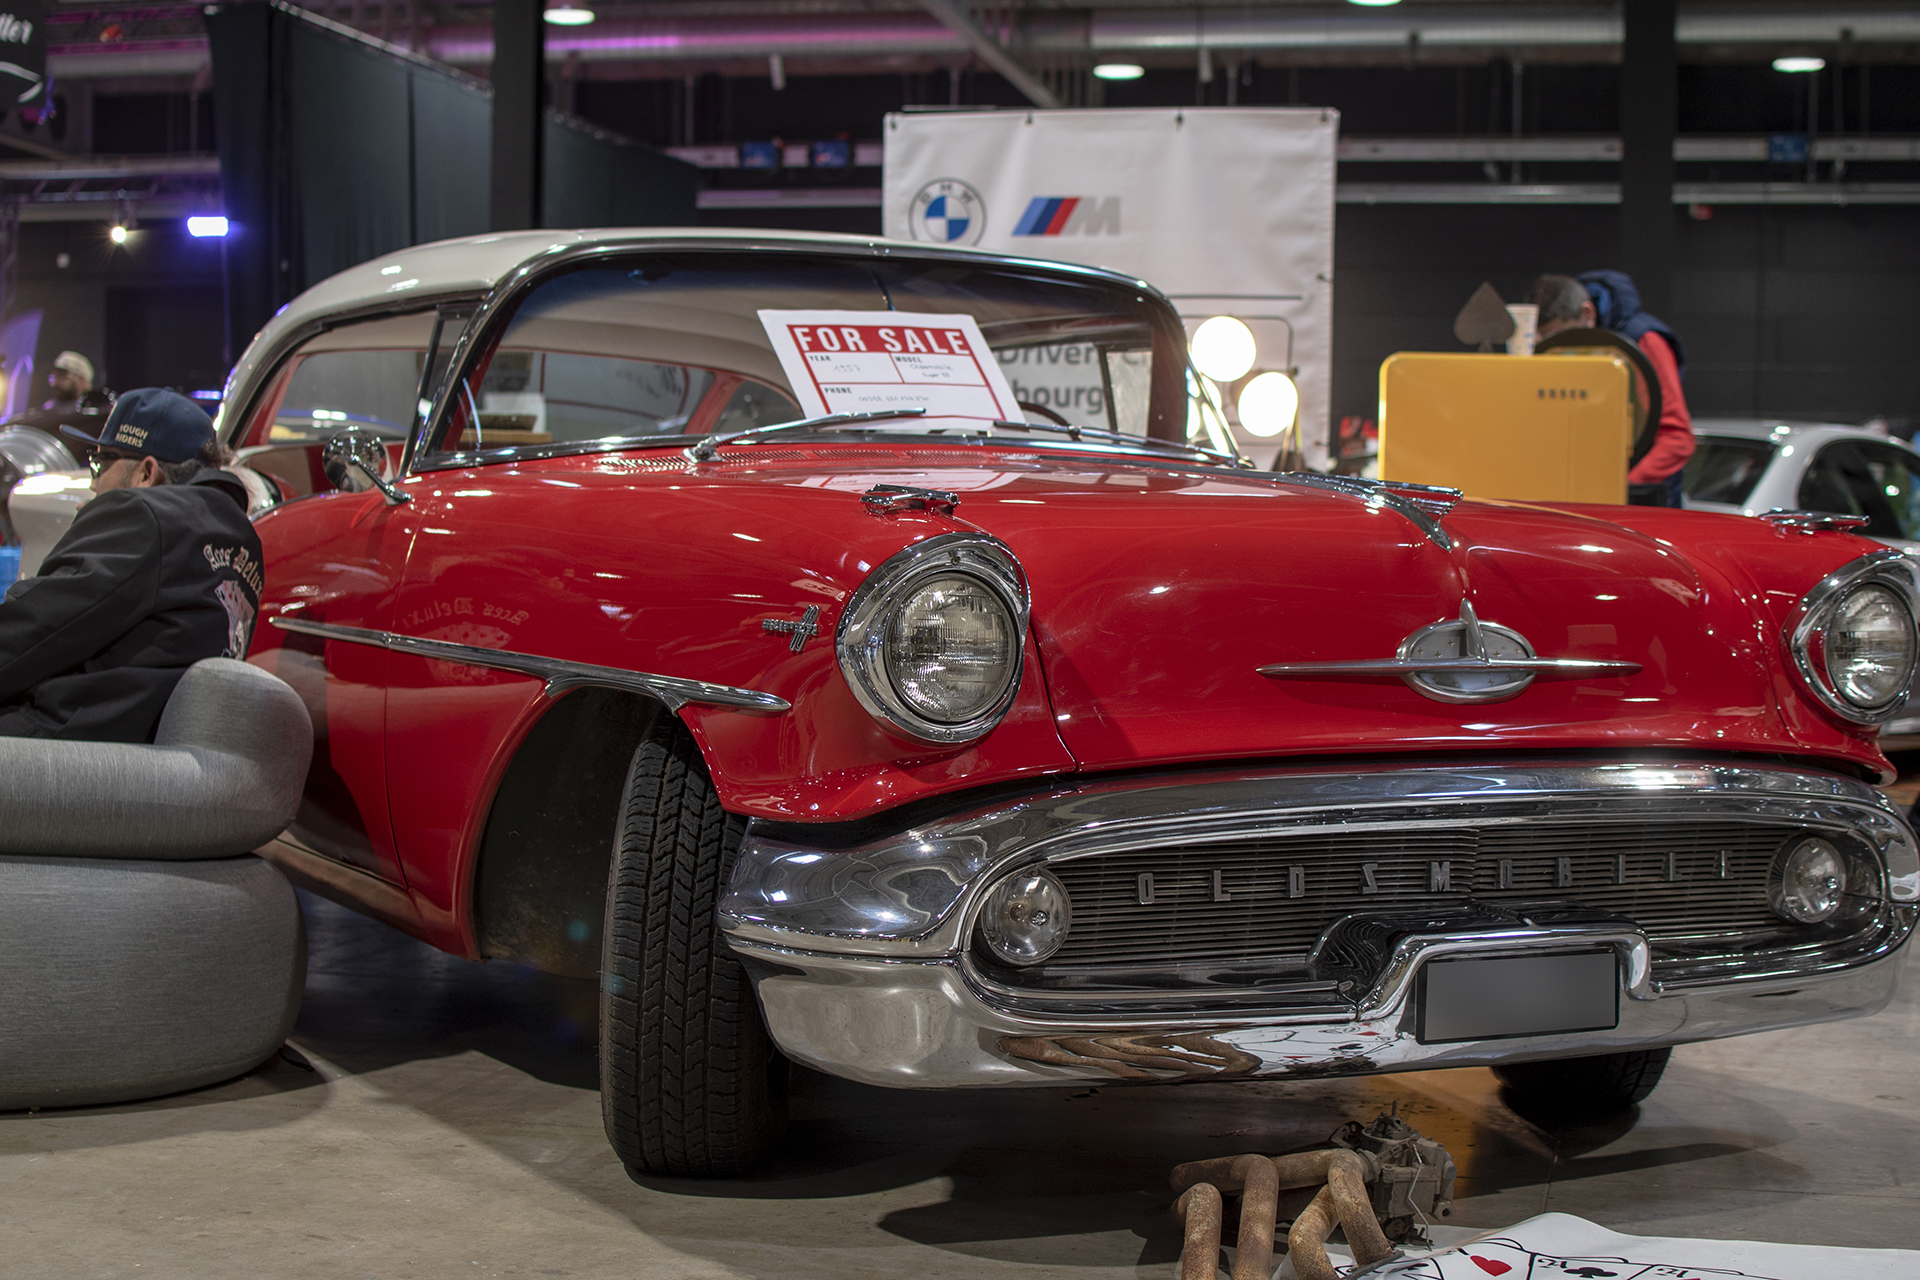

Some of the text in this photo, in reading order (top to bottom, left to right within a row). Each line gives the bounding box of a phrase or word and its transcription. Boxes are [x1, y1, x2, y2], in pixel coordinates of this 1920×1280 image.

[793, 326, 970, 355] FOR SALE
[203, 543, 234, 571] Aces
[1136, 850, 1734, 905] OLDSMOBILE
